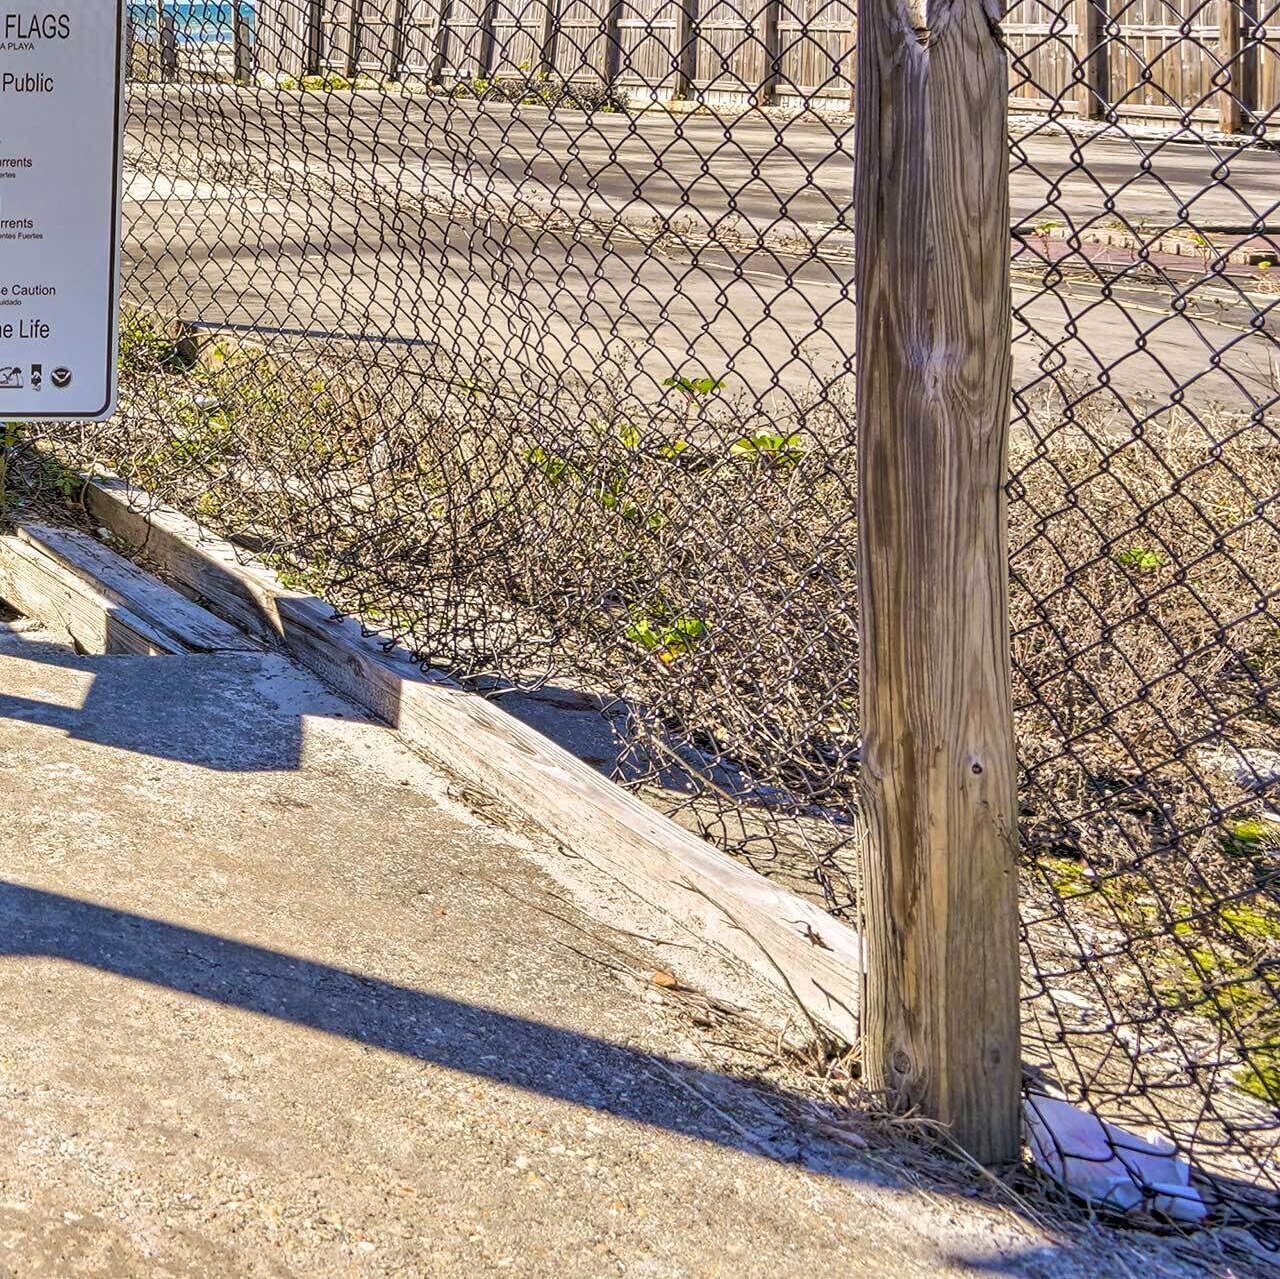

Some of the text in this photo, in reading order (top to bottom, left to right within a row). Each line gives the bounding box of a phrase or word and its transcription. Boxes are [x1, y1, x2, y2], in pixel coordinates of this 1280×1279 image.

[5, 13, 70, 39] FLAGS
[7, 42, 34, 50] PLAYA
[2, 72, 53, 92] Public
[11, 284, 56, 295] Caution
[19, 319, 49, 338] Life
